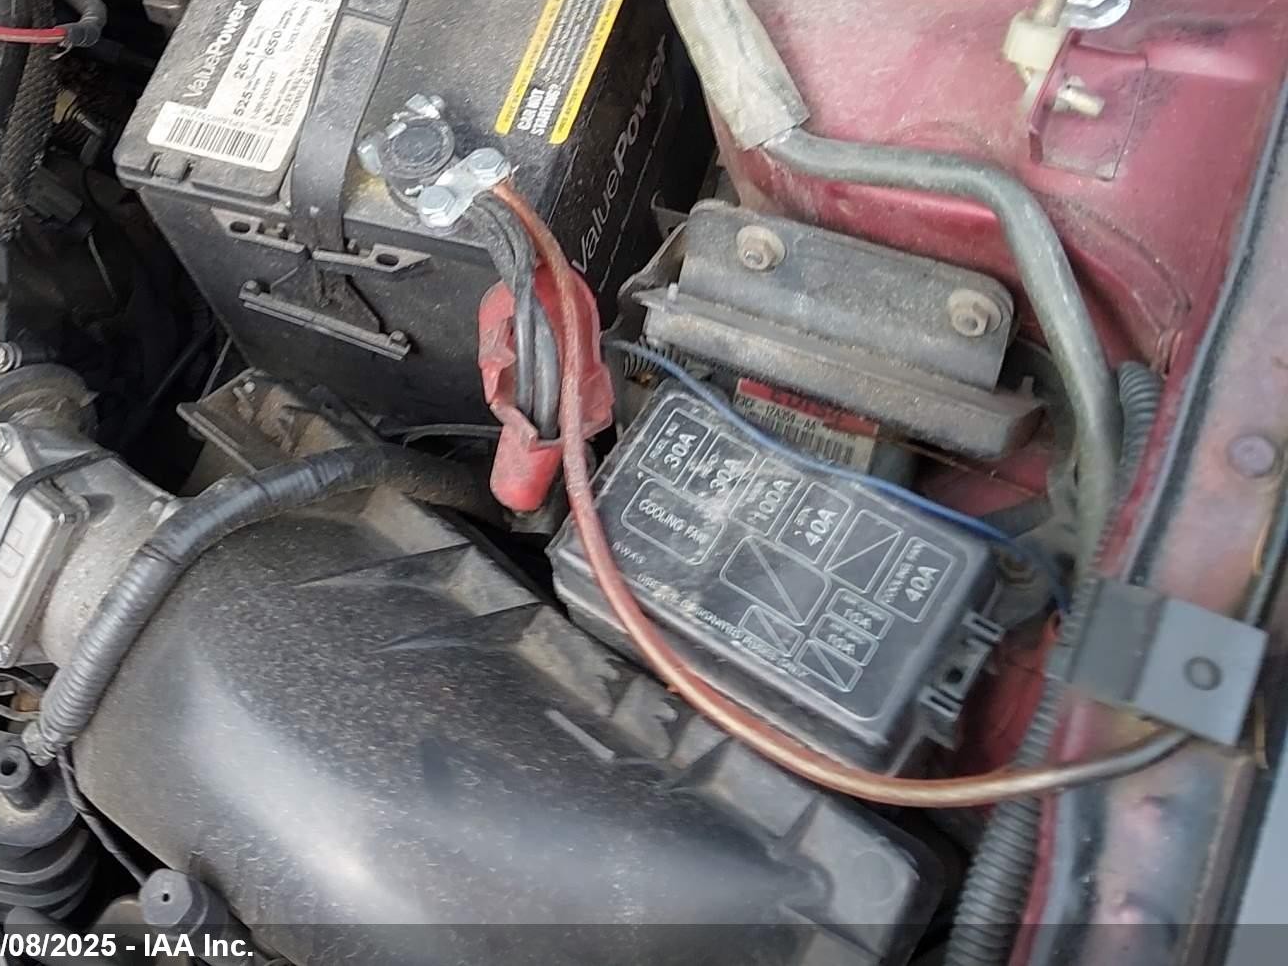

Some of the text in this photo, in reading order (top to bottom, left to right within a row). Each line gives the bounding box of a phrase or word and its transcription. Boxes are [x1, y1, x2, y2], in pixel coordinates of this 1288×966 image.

[182, 0, 249, 98] ValuePower
[264, 30, 282, 55] 650
[233, 91, 253, 117] 525
[517, 107, 539, 131] CAR
[571, 34, 666, 274] ValuePower
[663, 433, 698, 470] 30A
[638, 498, 688, 533] COOLING
[805, 508, 839, 547] 40A
[904, 565, 940, 603] 40A
